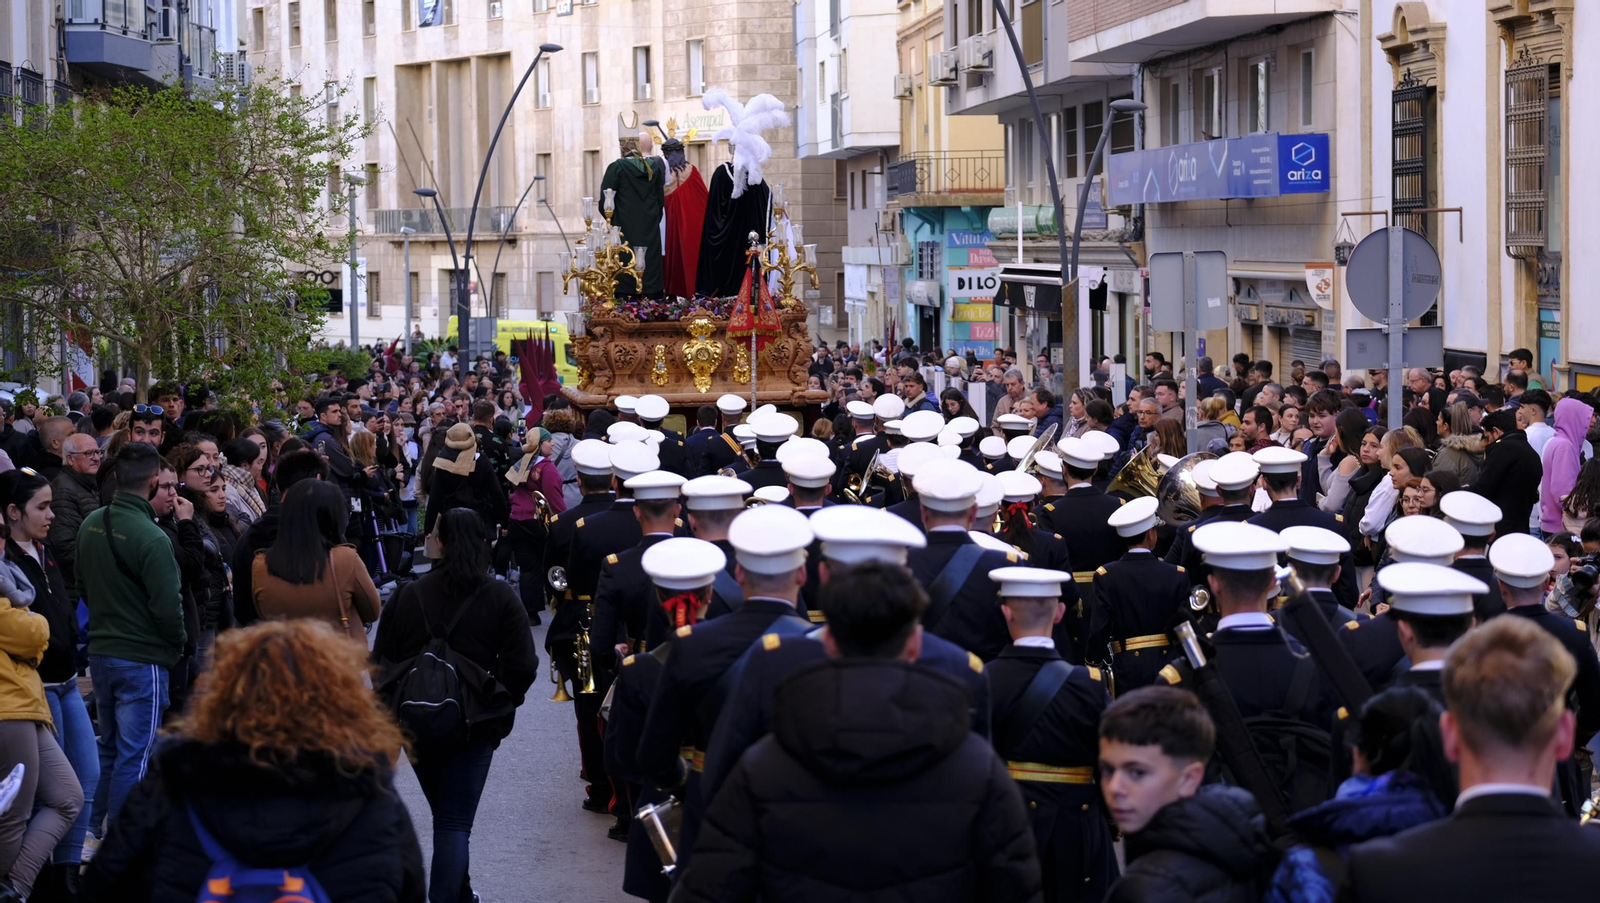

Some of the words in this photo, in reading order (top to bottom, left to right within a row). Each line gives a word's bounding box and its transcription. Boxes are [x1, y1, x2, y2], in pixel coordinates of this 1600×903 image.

[682, 109, 724, 130] Asempal
[1287, 168, 1322, 181] ariza
[958, 276, 996, 290] DILO
